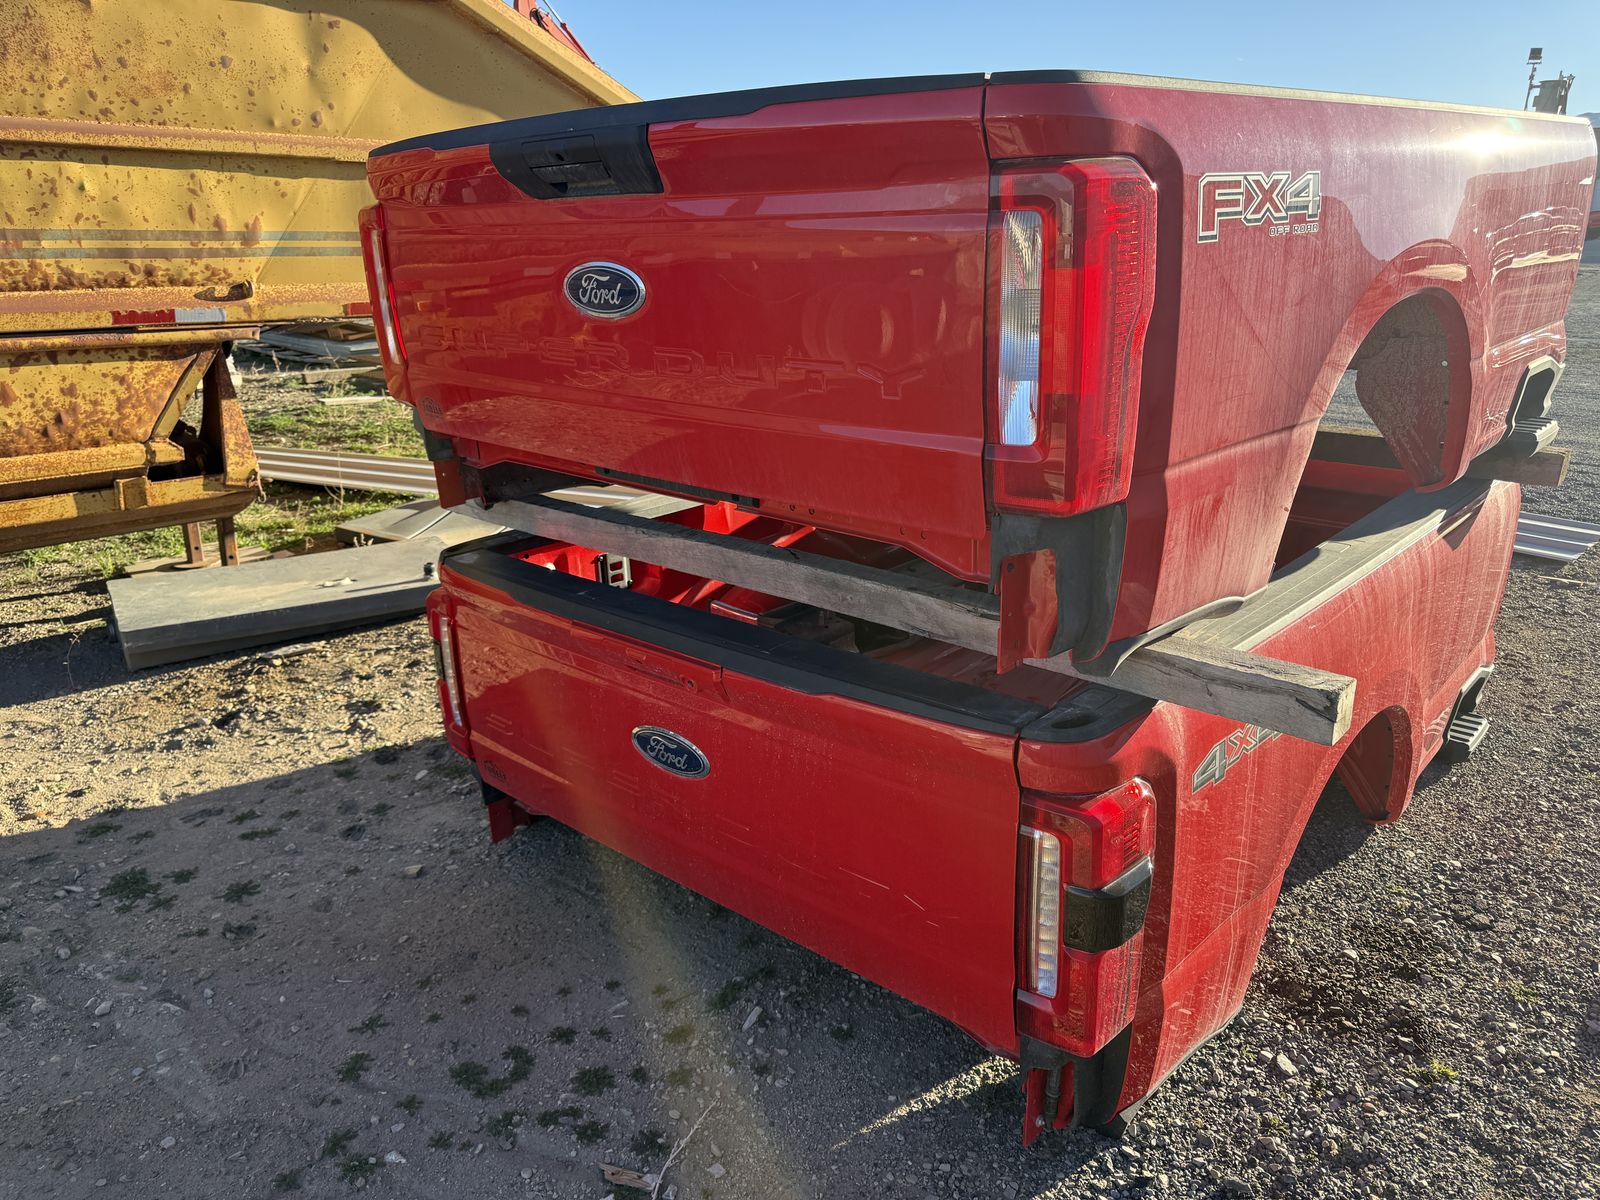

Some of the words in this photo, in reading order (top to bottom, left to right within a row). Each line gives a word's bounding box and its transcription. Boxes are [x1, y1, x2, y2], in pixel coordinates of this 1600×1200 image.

[1197, 171, 1321, 243] FX4
[1269, 225, 1290, 236] OFF
[579, 273, 622, 305] Ford
[653, 346, 927, 400] DUTY
[646, 735, 688, 769] Ford
